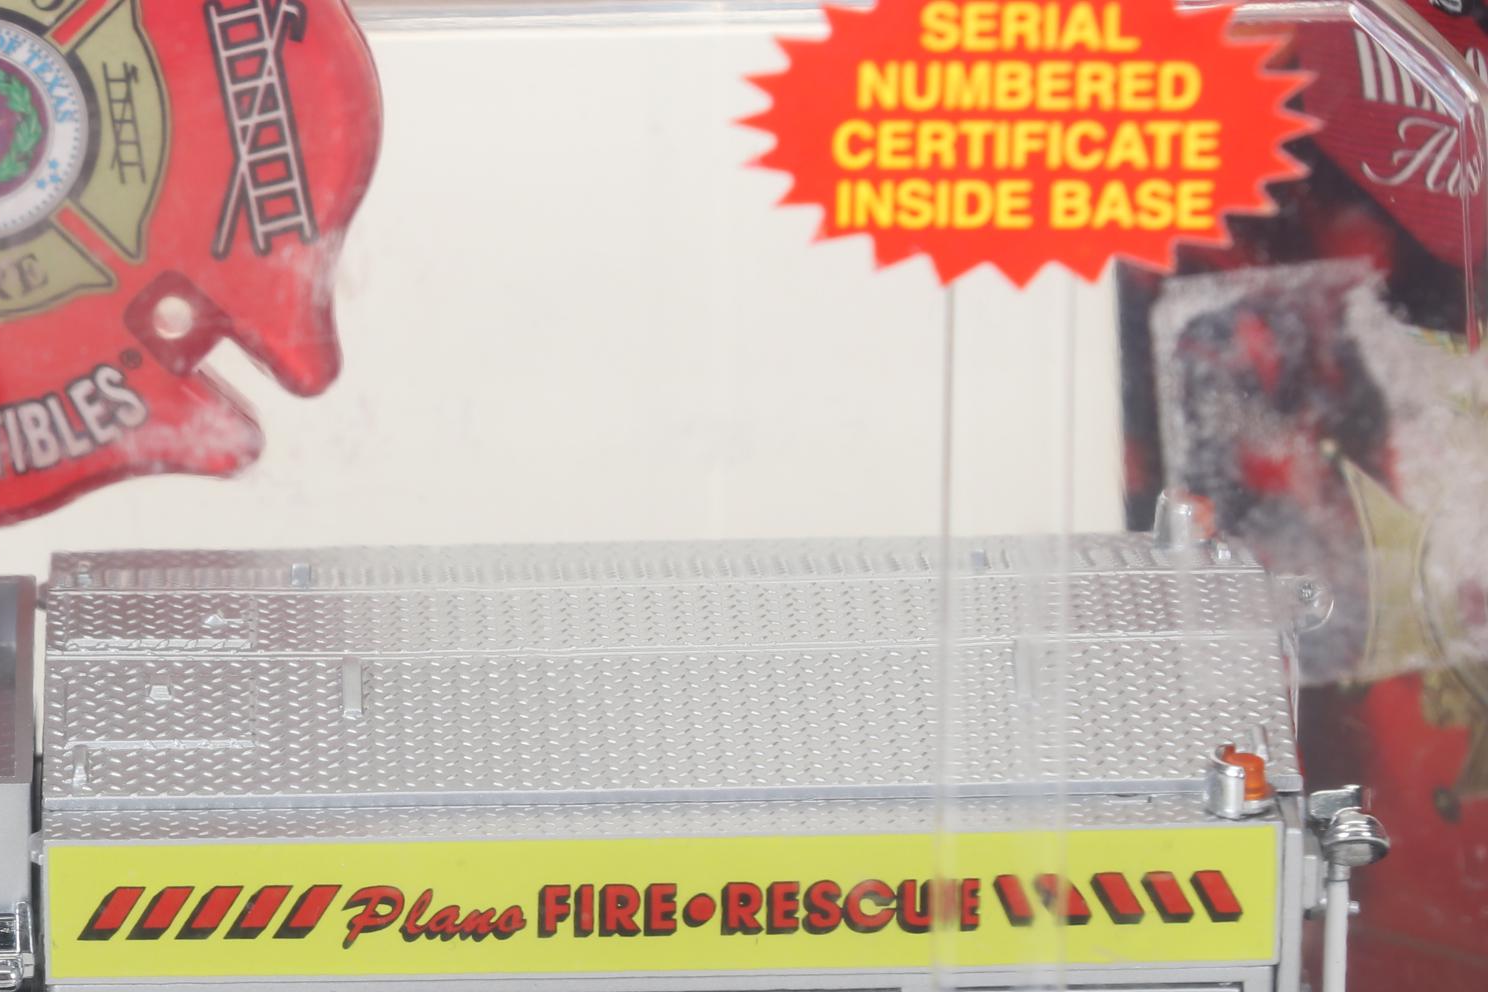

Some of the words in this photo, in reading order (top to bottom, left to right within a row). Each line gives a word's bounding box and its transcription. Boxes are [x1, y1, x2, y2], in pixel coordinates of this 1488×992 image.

[919, 1, 1141, 53] SERIAL
[25, 47, 73, 124] TEXAS
[856, 60, 1202, 112] NUMBERED
[832, 119, 1222, 171] CERTIFICATE
[835, 178, 1034, 230] INSIDE
[1050, 178, 1216, 230] BASE
[341, 884, 528, 949] Plano
